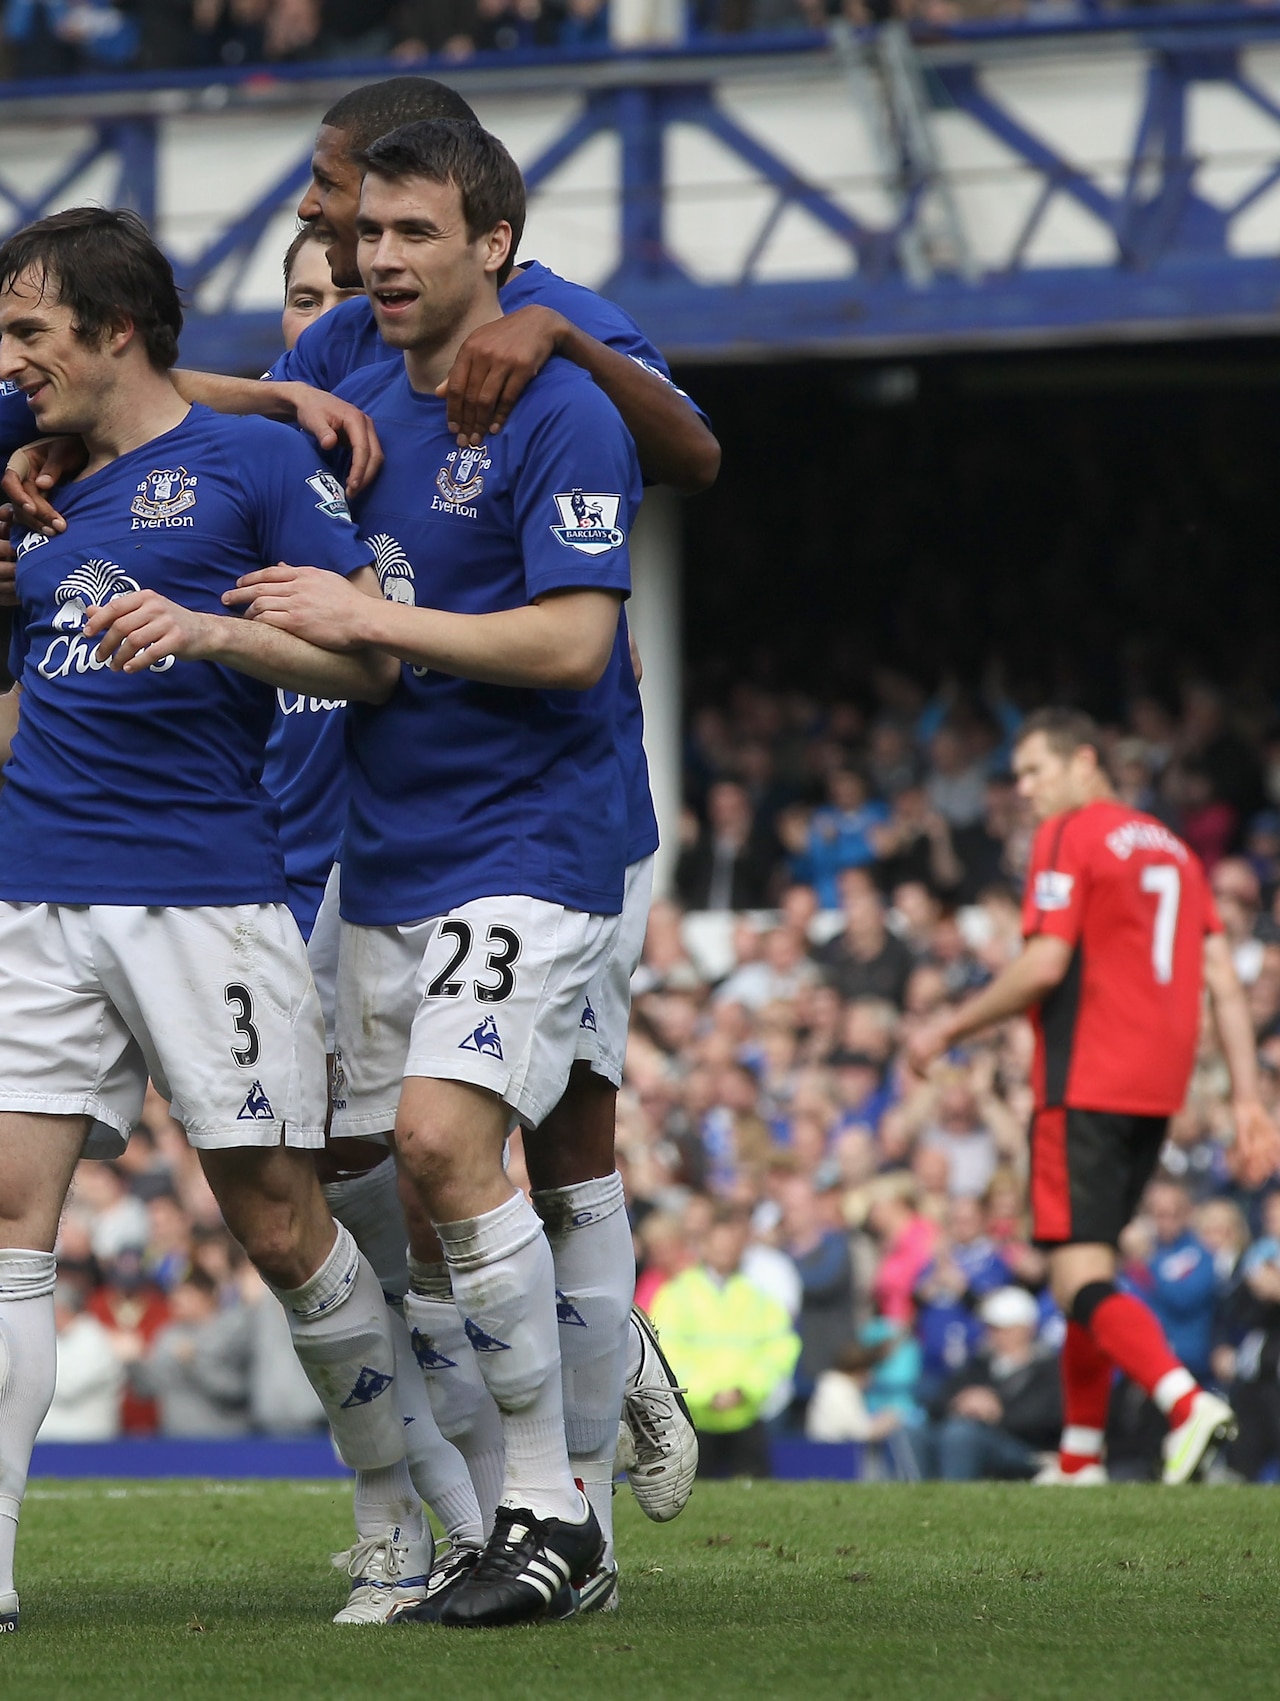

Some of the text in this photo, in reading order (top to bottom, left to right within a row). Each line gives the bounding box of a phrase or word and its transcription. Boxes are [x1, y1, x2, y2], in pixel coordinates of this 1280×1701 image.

[184, 476, 198, 487] 78
[430, 495, 478, 519] Everton
[131, 516, 194, 530] Everton
[566, 530, 607, 538] BARCLAYS
[1140, 864, 1181, 984] 7
[424, 917, 523, 1005] 23
[224, 981, 262, 1069] 3
